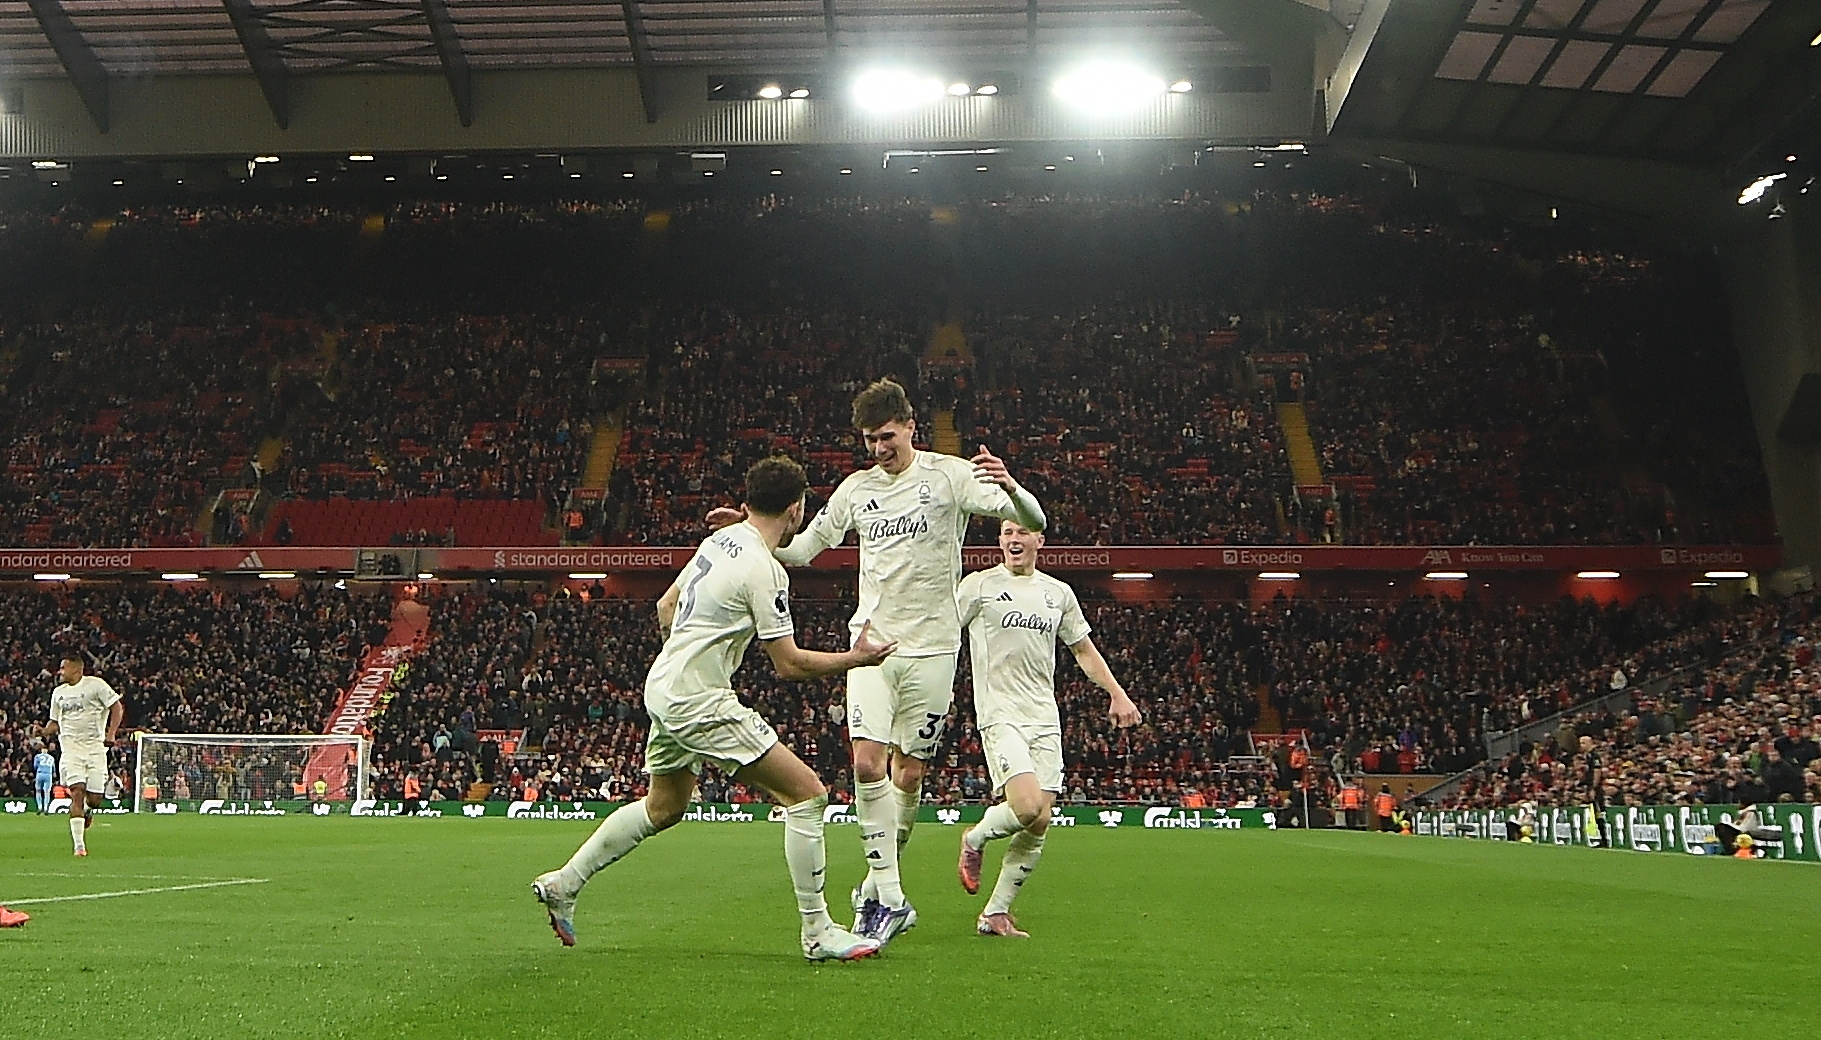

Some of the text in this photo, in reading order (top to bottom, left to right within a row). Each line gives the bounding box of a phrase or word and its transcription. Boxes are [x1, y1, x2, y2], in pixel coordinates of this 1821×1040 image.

[869, 514, 928, 541] Bally's
[0, 553, 132, 567] ndard chartered
[511, 552, 672, 566] standard chartered
[1241, 551, 1302, 566] Expedia
[1420, 550, 1452, 564] AXA
[1461, 553, 1494, 562] Know
[1521, 553, 1544, 562] Can
[1680, 549, 1743, 565] Expedia
[1001, 610, 1053, 635] Bally's
[330, 666, 395, 735] Foundatio
